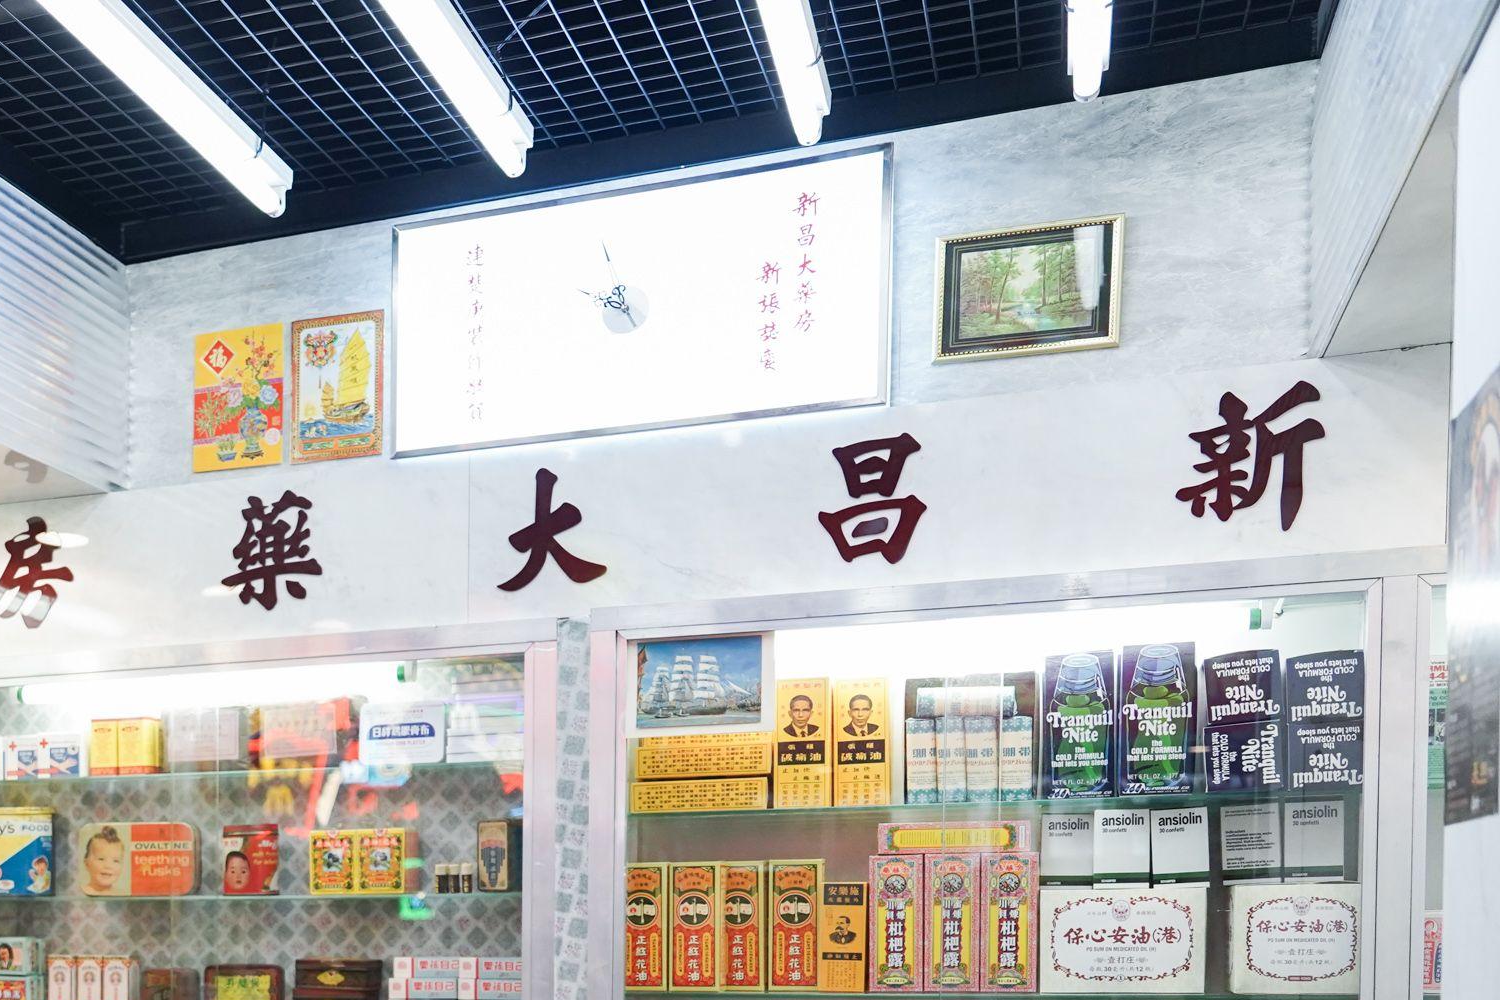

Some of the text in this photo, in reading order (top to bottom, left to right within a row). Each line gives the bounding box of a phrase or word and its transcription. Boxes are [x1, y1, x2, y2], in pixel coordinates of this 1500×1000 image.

[1225, 685, 1264, 702] Nite
[1307, 686, 1347, 702] Nite
[1121, 702, 1192, 722] Tranquil
[1211, 699, 1280, 721] Tranquil
[1291, 702, 1362, 721] Tranquil
[1046, 709, 1113, 729] Tranquil
[1062, 727, 1099, 744] Nite
[1138, 720, 1177, 737] Nite
[781, 752, 822, 763] 破痛油
[840, 752, 882, 763] 破痛油
[1055, 752, 1105, 762] COLD FORMULA
[1131, 746, 1183, 756] COLD FORMULA
[1242, 738, 1260, 774] Nite
[1259, 724, 1281, 785] Tranquil
[1309, 752, 1348, 770] Nite
[1293, 769, 1363, 788] Tranquil
[1102, 812, 1145, 827] ansiolin
[1158, 810, 1203, 826] ansiolin
[1292, 805, 1338, 819] ansiolin
[21, 824, 50, 832] FOOD
[1048, 814, 1090, 831] ansiolin
[134, 842, 189, 851] OVALTINE
[134, 853, 190, 868] teething
[140, 866, 181, 878] rusks
[637, 935, 651, 981] 正紅花油
[687, 935, 702, 981] 正紅花油
[731, 935, 745, 981] 正紅花油
[788, 935, 801, 981] 正紅花油
